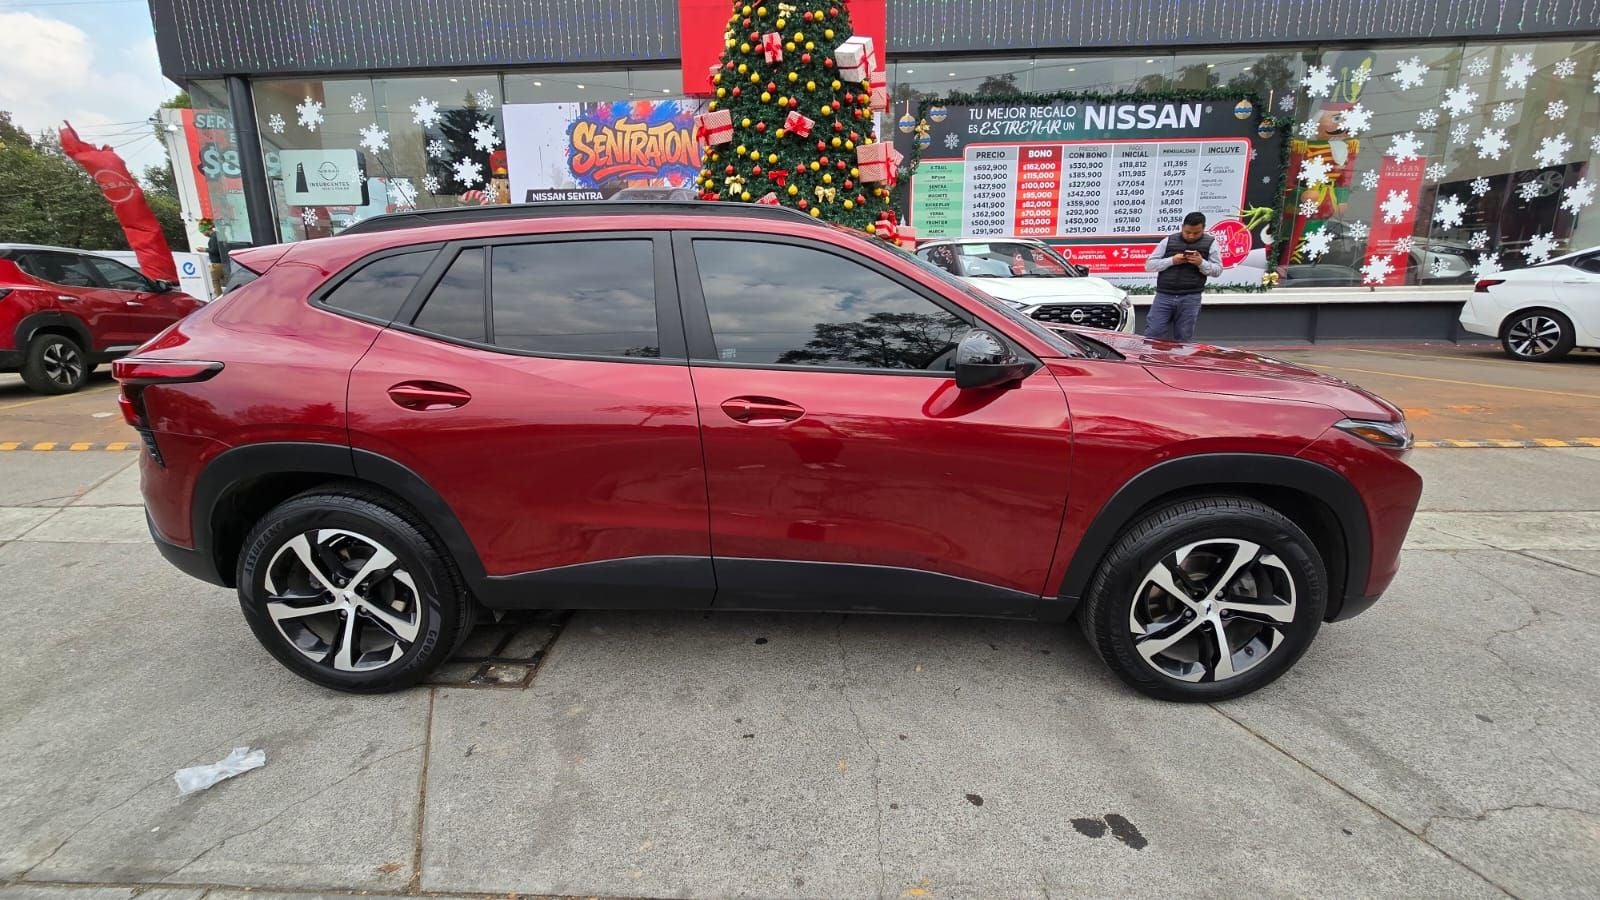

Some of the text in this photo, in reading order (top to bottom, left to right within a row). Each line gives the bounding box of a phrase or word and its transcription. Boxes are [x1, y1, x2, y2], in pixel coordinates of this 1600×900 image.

[969, 106, 1077, 120] TU MEJOR REGALO
[1084, 103, 1202, 130] NISSAN
[968, 119, 1075, 136] ES ESTRENAR UN
[572, 117, 702, 174] SENTRATON
[1028, 150, 1052, 158] BONO
[1203, 163, 1212, 174] 4
[532, 191, 604, 201] NISSAN SENTRA
[1067, 190, 1101, 198] $342,900
[972, 202, 1005, 210] $441,900
[1020, 218, 1051, 226] $50,000
[1020, 227, 1050, 235] $40,000
